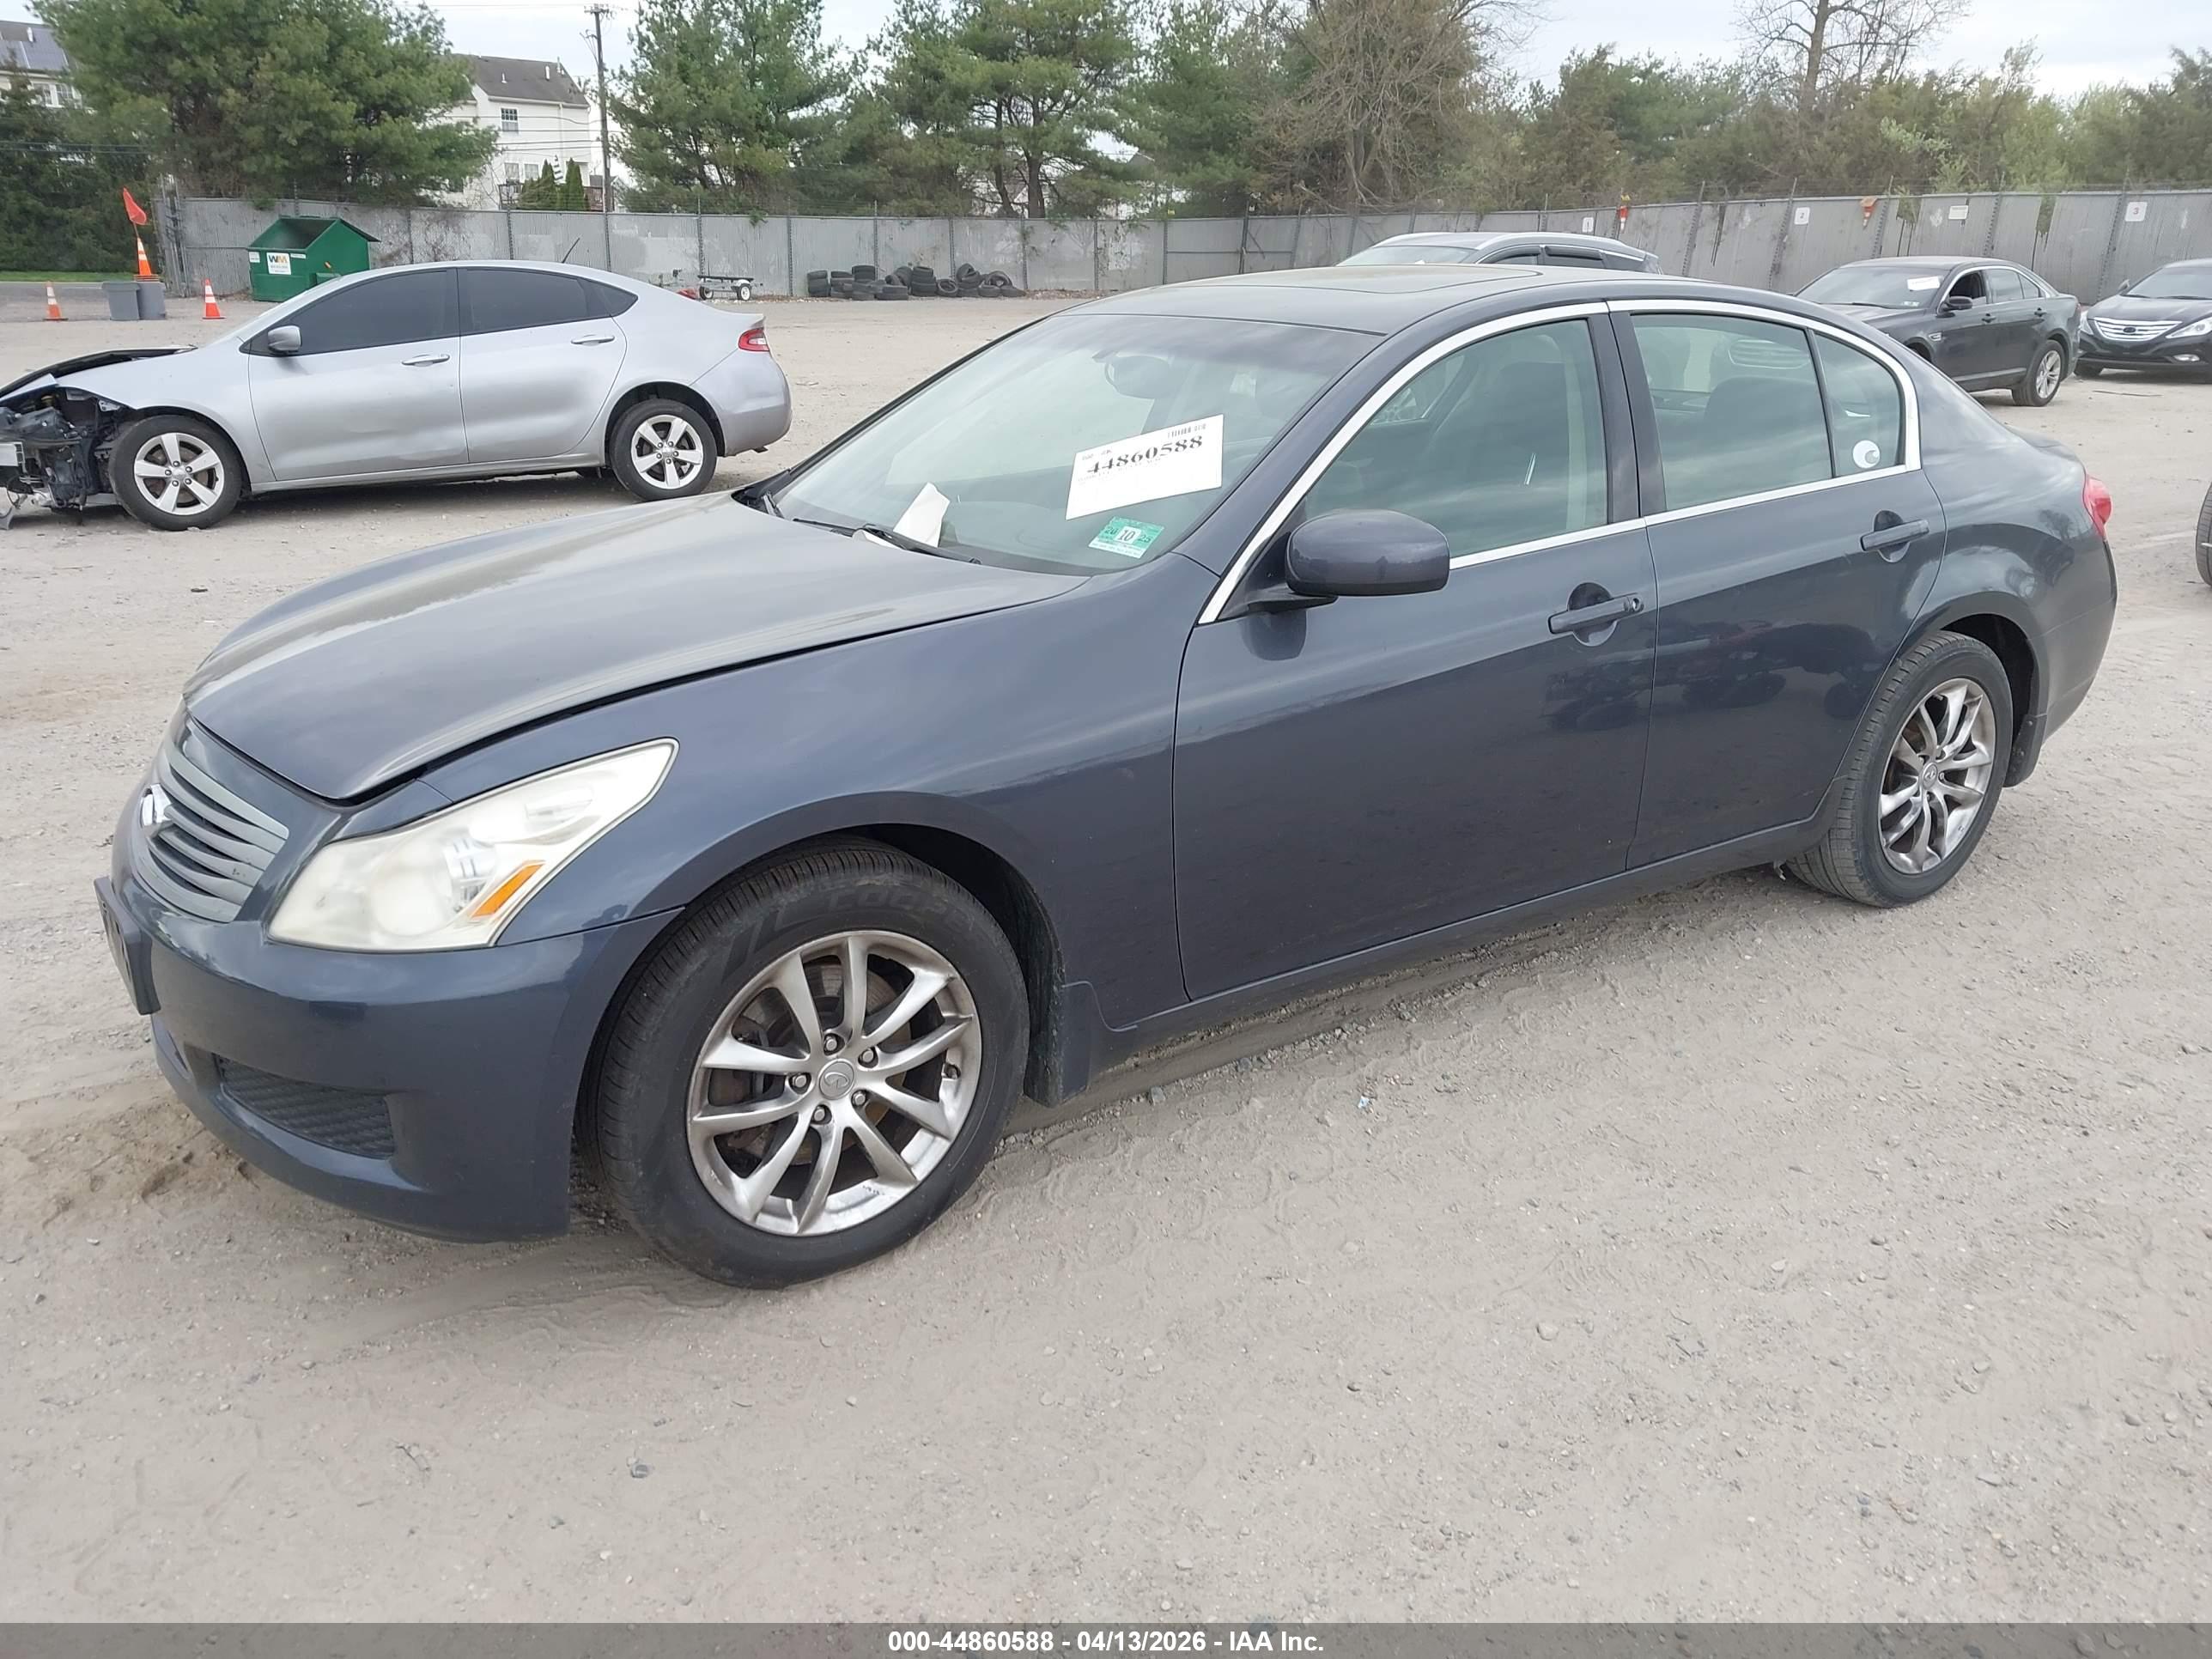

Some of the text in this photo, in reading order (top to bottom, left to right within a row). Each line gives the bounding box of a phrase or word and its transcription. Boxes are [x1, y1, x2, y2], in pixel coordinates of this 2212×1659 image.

[268, 254, 289, 264] WM
[1087, 435, 1203, 473] 44860588
[1117, 528, 1137, 542] 10
